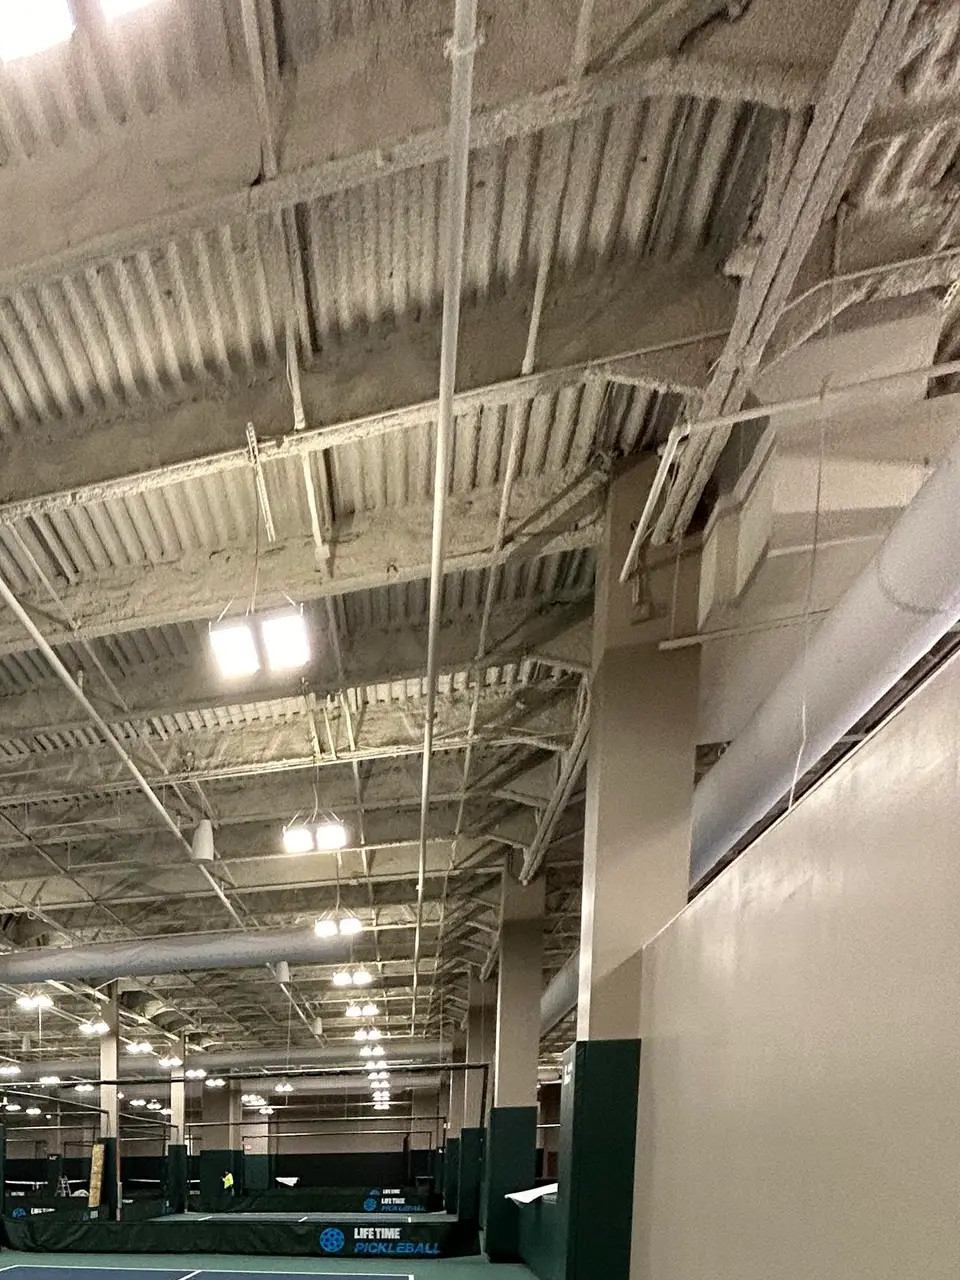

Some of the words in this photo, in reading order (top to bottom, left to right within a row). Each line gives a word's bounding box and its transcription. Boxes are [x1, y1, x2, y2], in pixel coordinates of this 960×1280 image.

[354, 1228, 374, 1239] LIFE
[375, 1228, 401, 1239] TIME
[354, 1243, 440, 1254] PICKLEBALL
